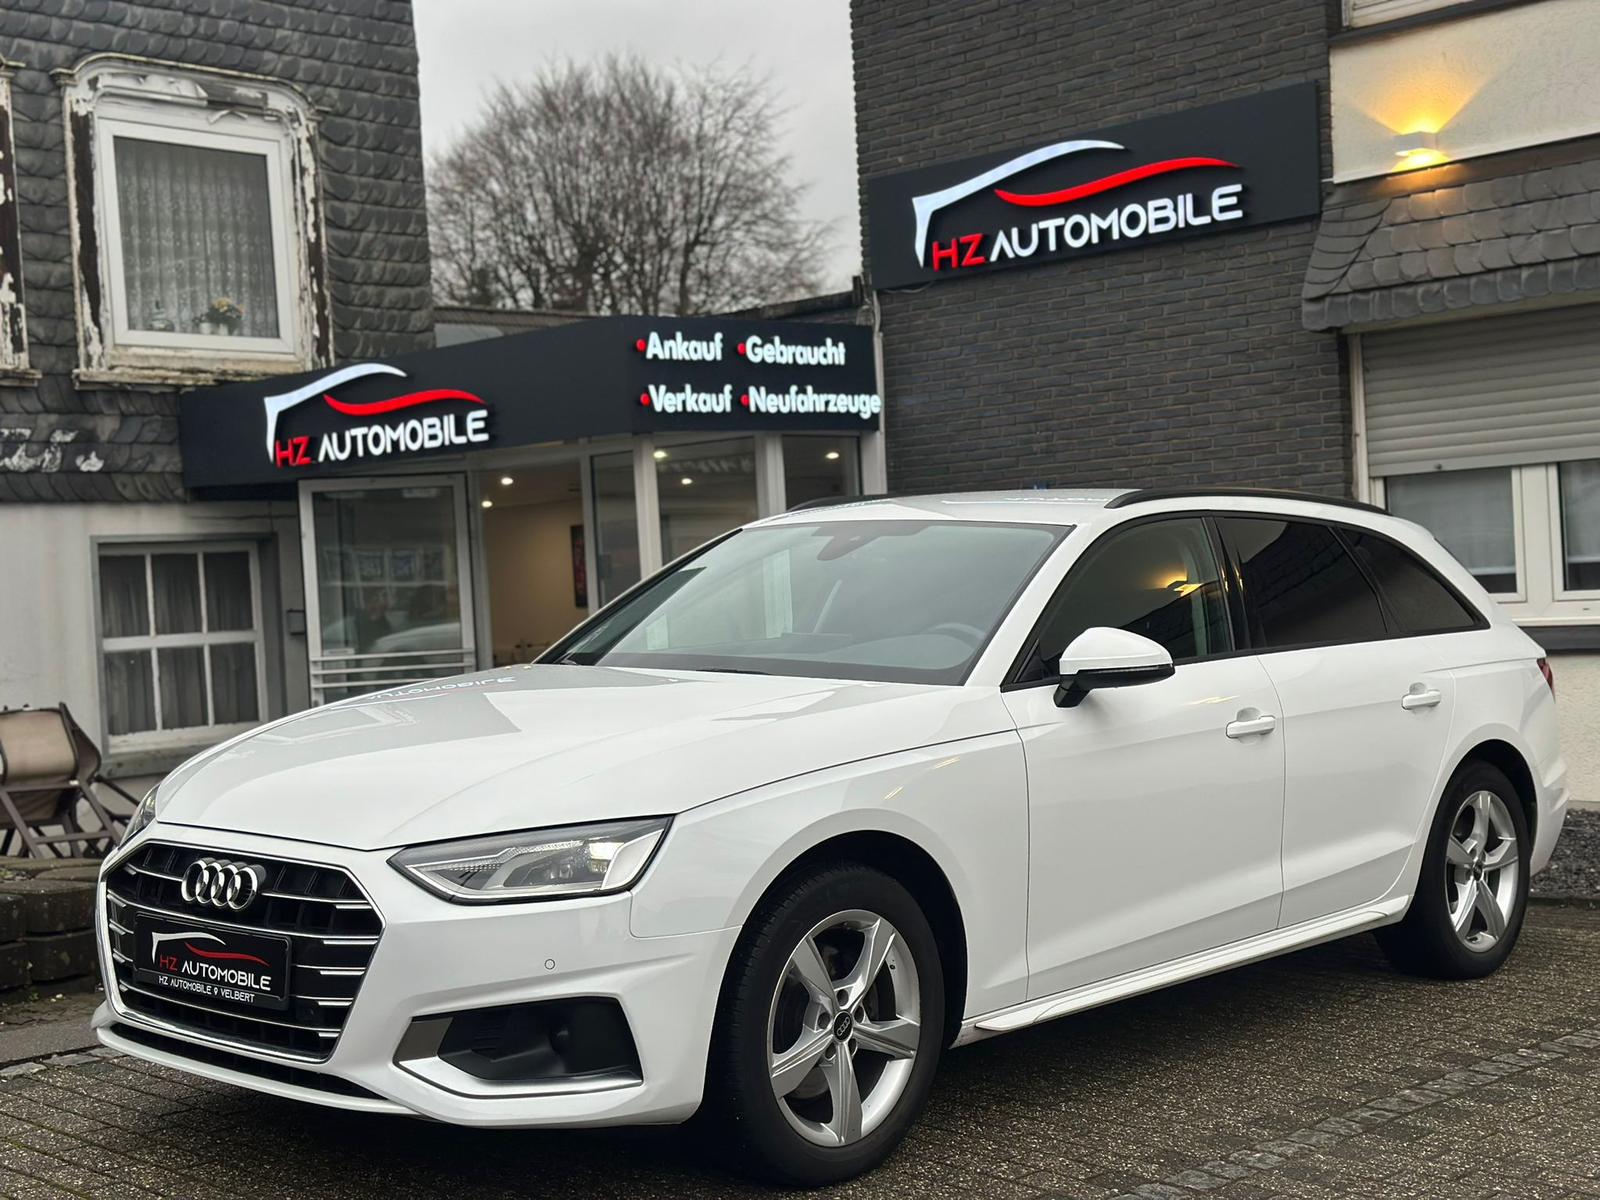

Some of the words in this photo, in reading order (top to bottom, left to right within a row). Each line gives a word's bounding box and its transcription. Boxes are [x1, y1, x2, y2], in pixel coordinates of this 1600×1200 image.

[932, 233, 985, 271] HZ
[989, 184, 1243, 262] AUTOMOBILE
[646, 331, 723, 361] Ankauf
[746, 335, 846, 366] Gebraucht
[648, 384, 732, 413] Verkauf
[748, 385, 882, 420] Neufahrzeuge
[275, 435, 312, 468] HZ
[318, 409, 489, 462] AUTOMOBILE
[158, 976, 169, 986] HZ
[170, 977, 212, 995] AUTOMOBILE
[220, 987, 255, 1003] VELBERT
[159, 953, 178, 972] HZ
[181, 960, 272, 991] AUTOMOBILE
